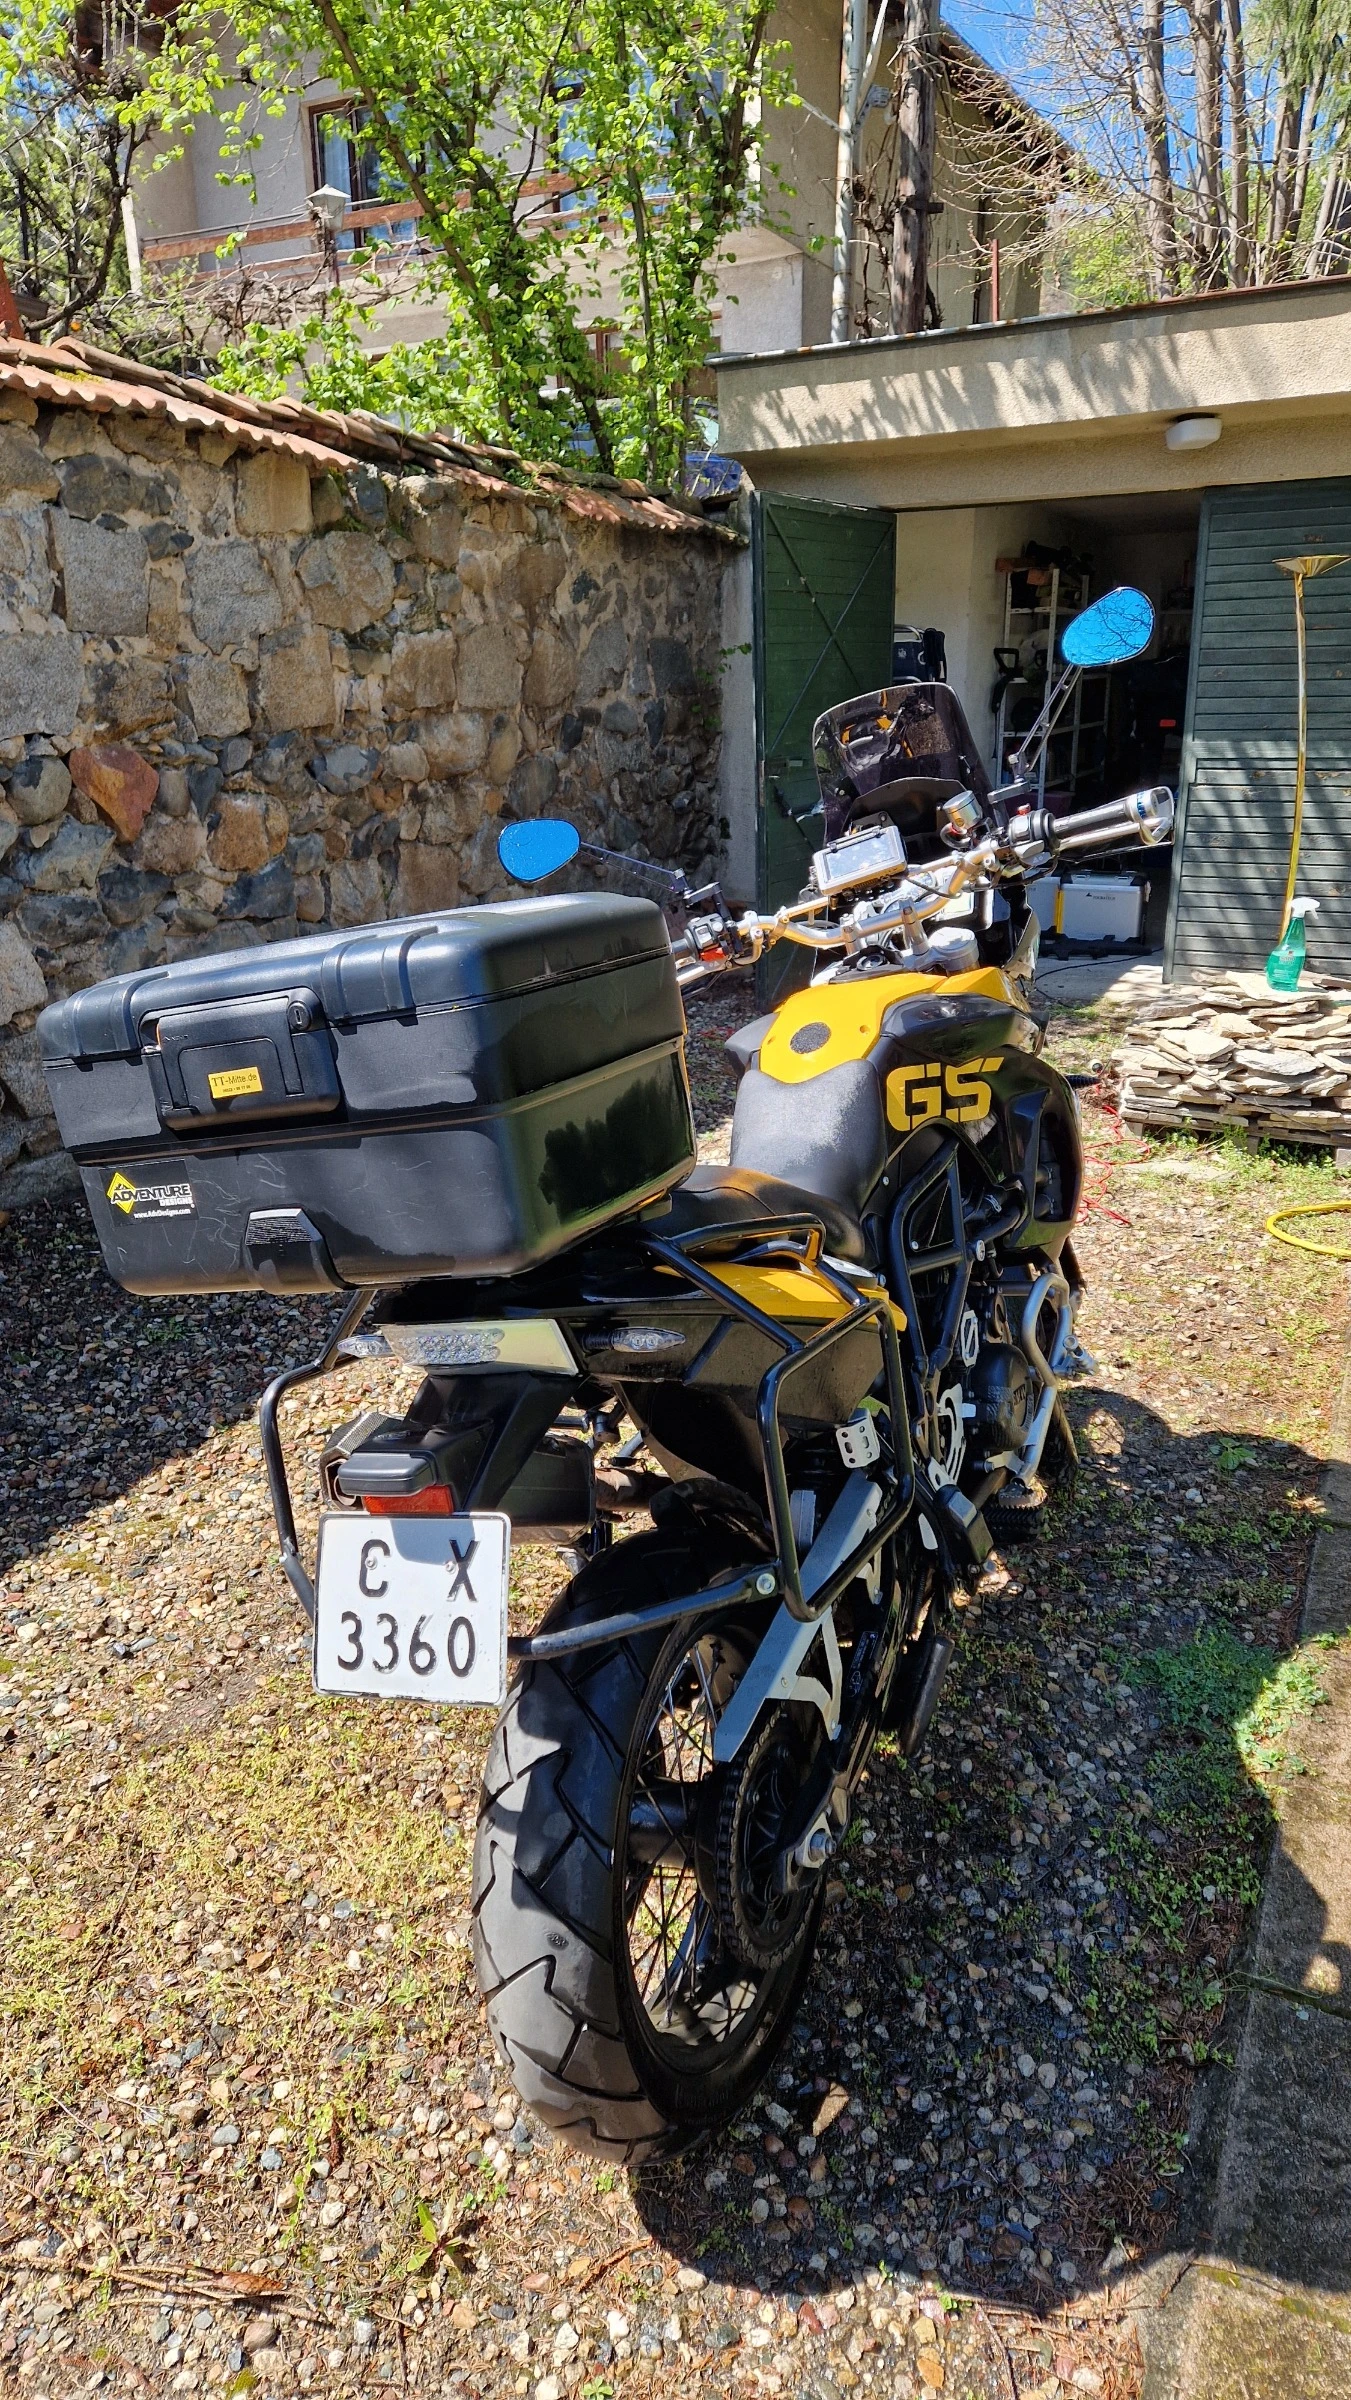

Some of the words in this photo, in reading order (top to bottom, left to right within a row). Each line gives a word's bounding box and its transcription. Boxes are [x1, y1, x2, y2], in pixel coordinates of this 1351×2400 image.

[211, 1073, 258, 1087] TT-Mitte.de
[886, 1056, 1005, 1132] GS
[111, 1184, 192, 1204] ADVENTURE
[159, 1197, 193, 1207] DESIGNS
[358, 1538, 391, 1598] C
[446, 1539, 481, 1602] X
[337, 1610, 477, 1678] 3360
